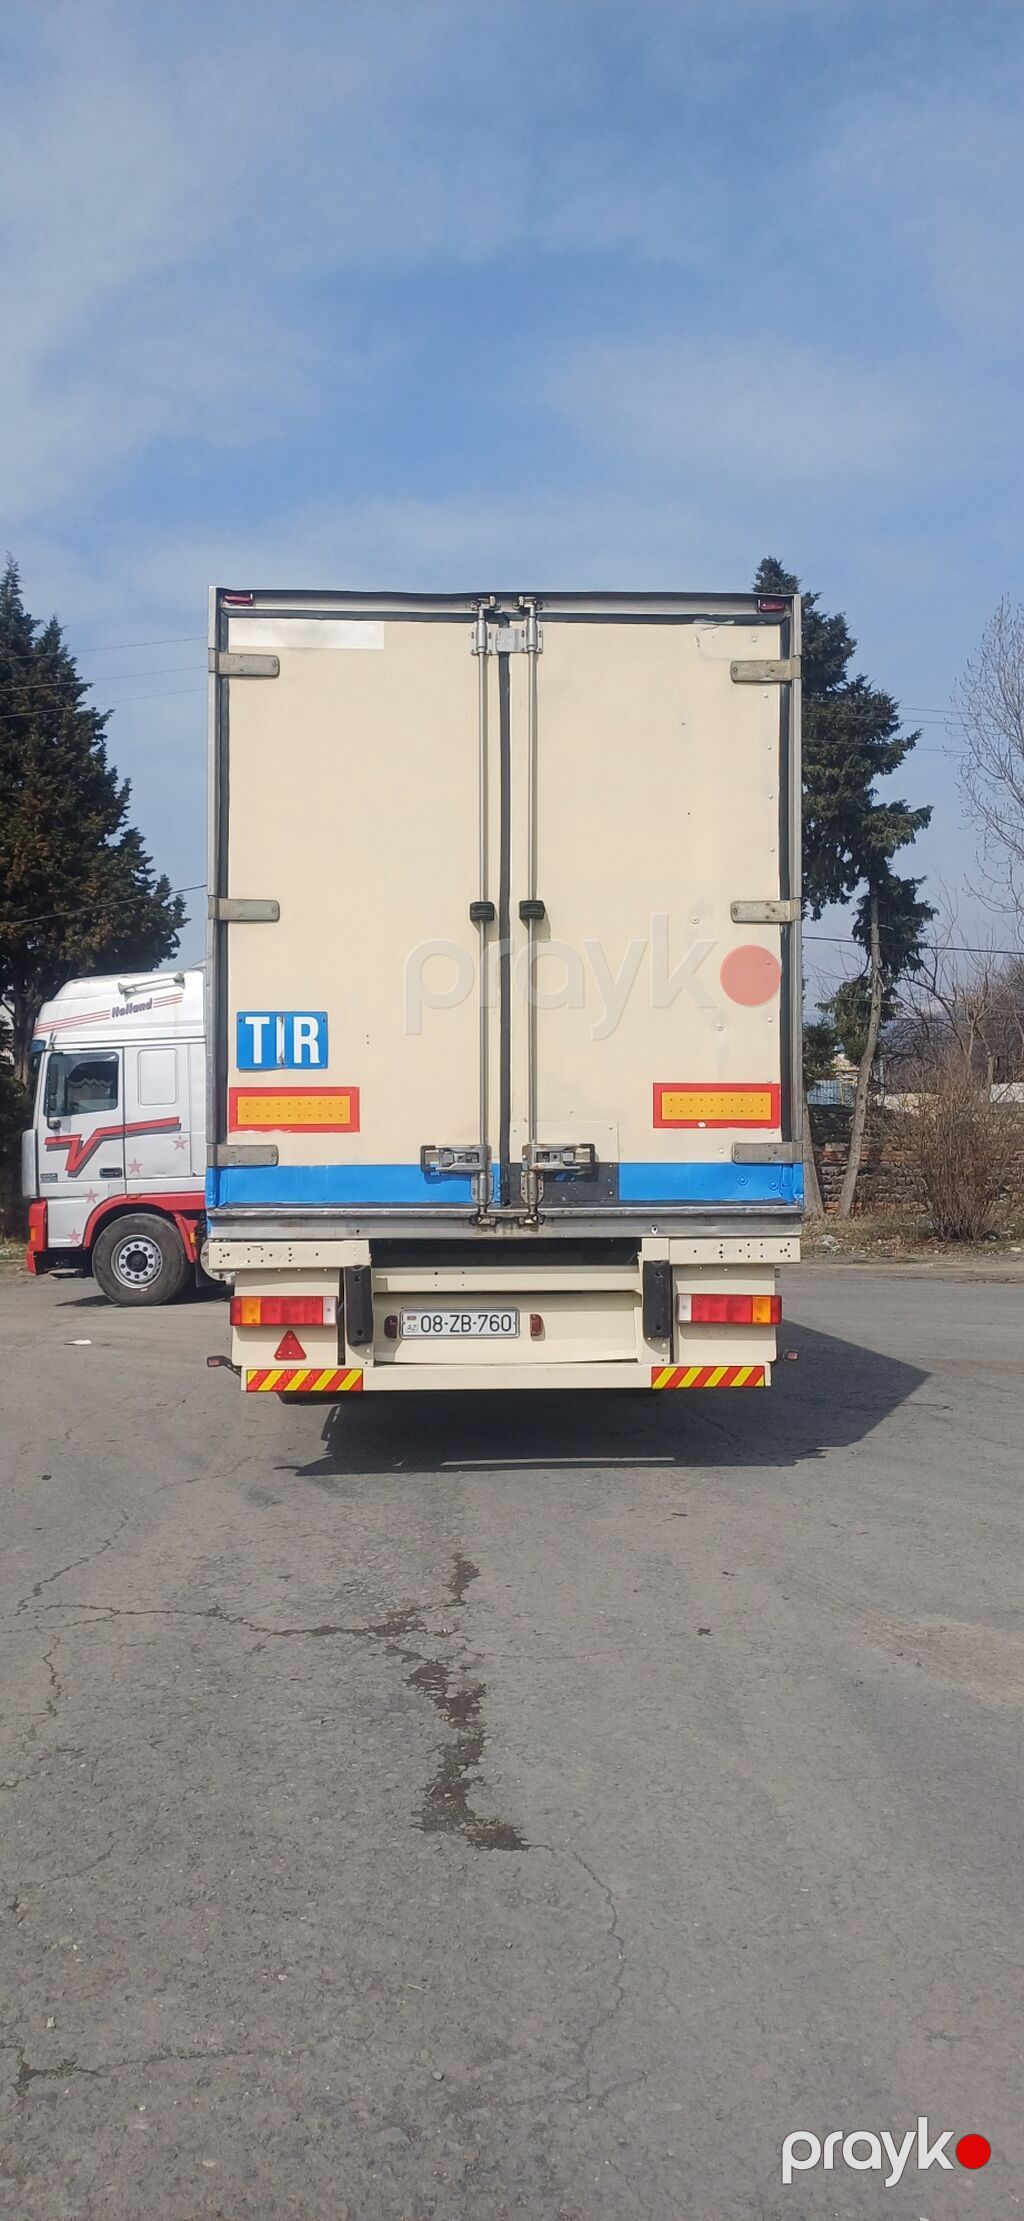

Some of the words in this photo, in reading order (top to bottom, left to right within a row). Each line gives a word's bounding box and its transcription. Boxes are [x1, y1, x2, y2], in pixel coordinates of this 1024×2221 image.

[111, 997, 153, 1018] Holland
[244, 1016, 321, 1064] TIR
[407, 1324, 417, 1332] AZ
[420, 1314, 512, 1333] 08-ZB-760
